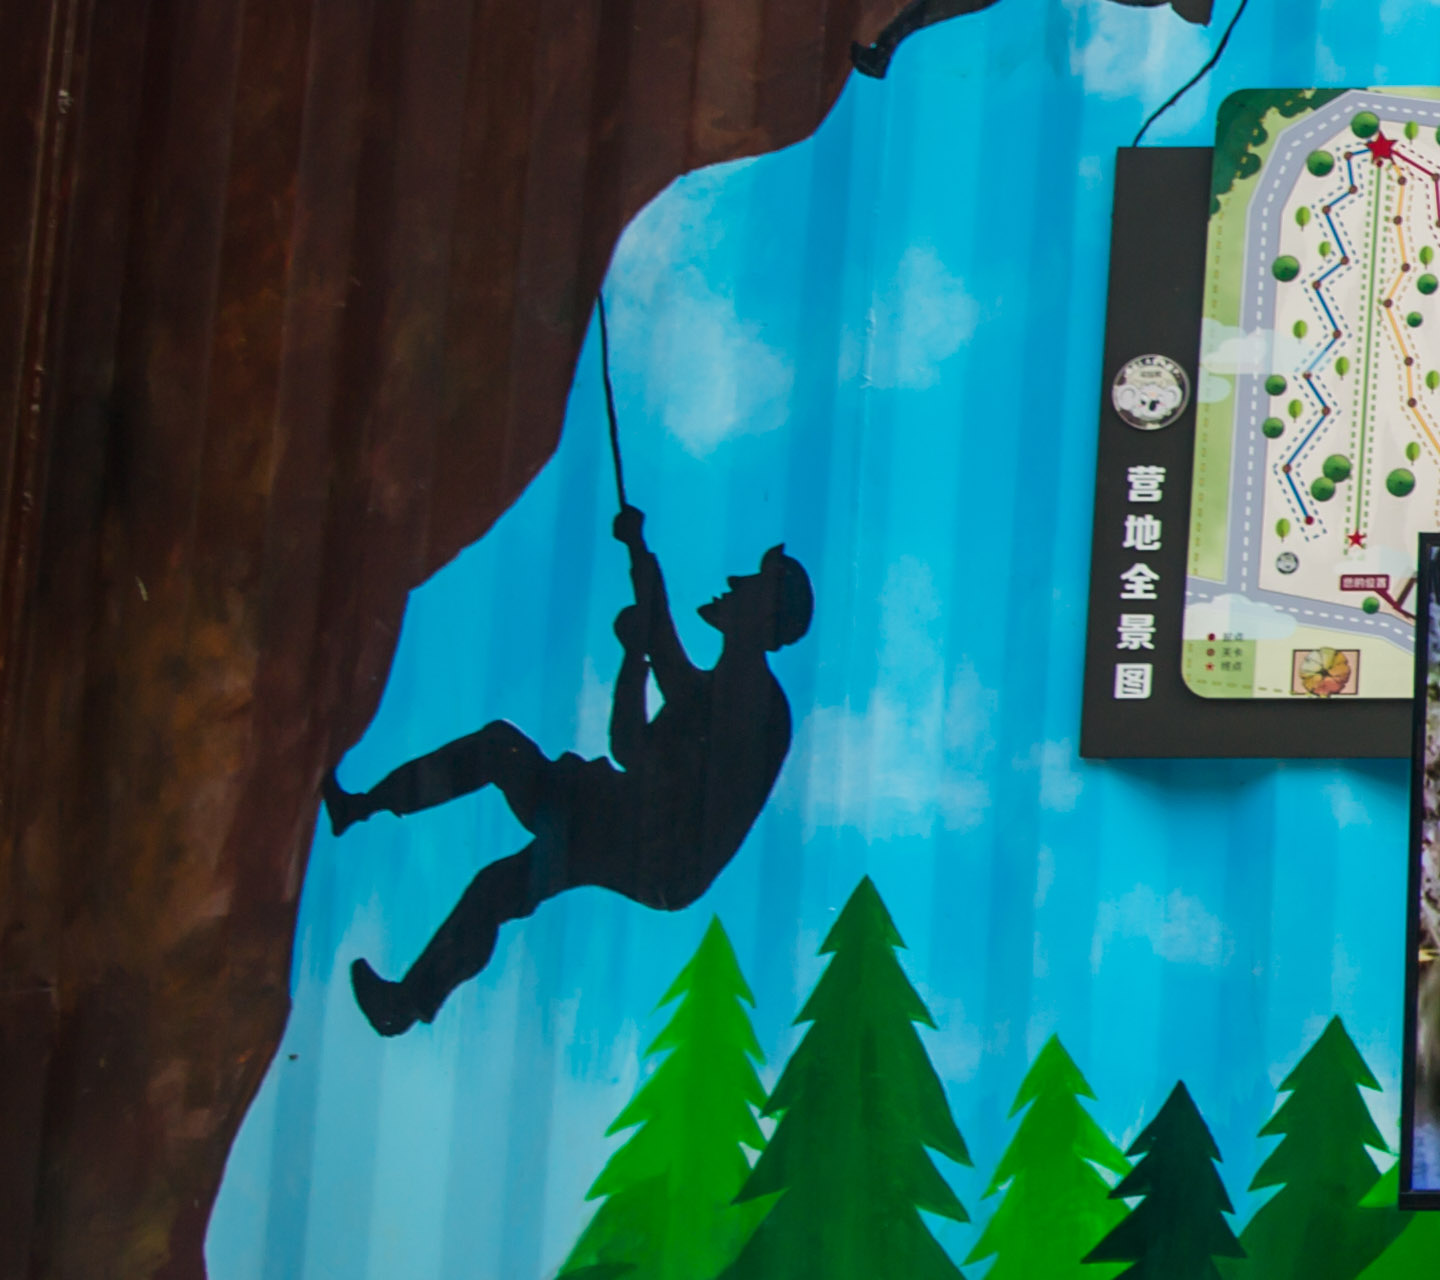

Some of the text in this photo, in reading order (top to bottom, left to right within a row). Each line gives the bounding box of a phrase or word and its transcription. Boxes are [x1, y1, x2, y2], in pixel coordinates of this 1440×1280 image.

[1113, 465, 1167, 701] 营地全景图
